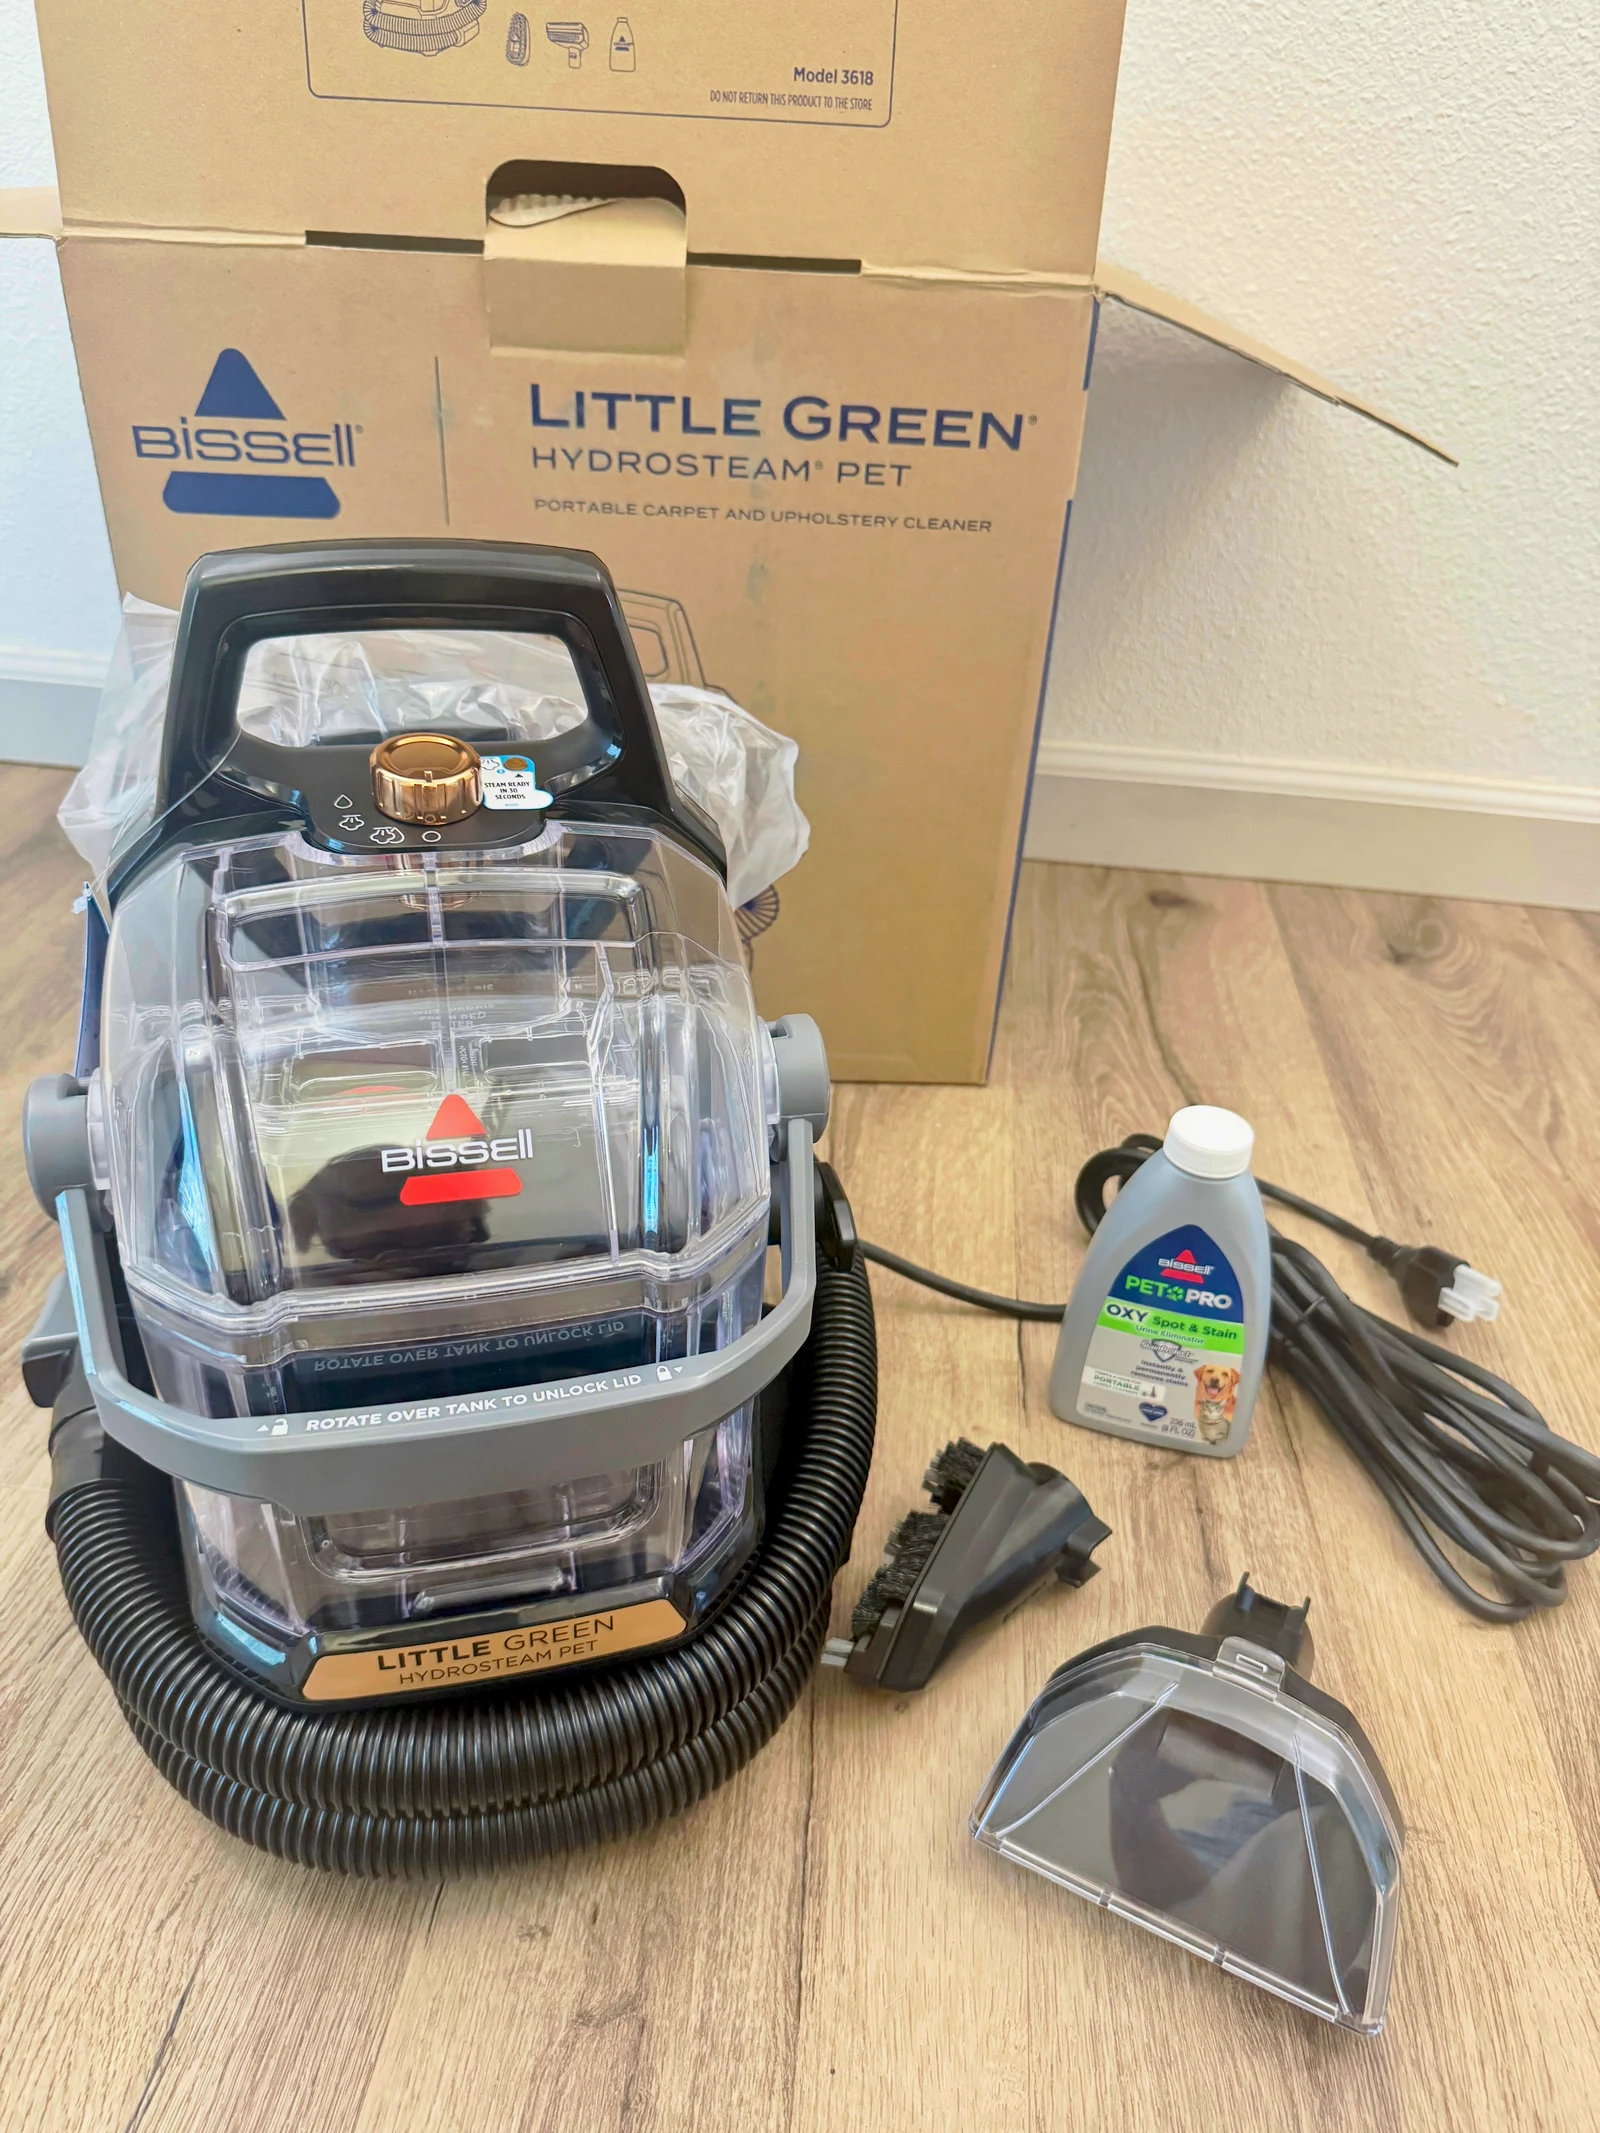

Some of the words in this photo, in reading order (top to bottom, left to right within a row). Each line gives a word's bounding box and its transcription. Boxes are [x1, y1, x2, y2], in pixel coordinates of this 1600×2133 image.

[793, 66, 837, 84] Model
[841, 70, 874, 86] 3618
[710, 89, 721, 103] DO
[722, 91, 737, 104] NOT
[739, 92, 769, 105] RETURN
[770, 93, 786, 106] THIS
[788, 94, 821, 108] PRODUCT
[823, 96, 833, 108] TO
[835, 97, 848, 109] THE
[850, 98, 872, 111] STORE
[529, 383, 761, 438] LITTLE
[836, 461, 913, 488] PET
[535, 498, 638, 517] PORTABLE
[643, 503, 720, 521] CARPET
[725, 507, 766, 523] AND
[771, 511, 899, 530] UPHOLSTERY
[903, 515, 993, 533] CLEANER
[1125, 1275, 1169, 1298] PET
[1185, 1288, 1232, 1310] PRO
[1106, 1303, 1148, 1322] OXY
[1152, 1315, 1185, 1332] Spot
[1188, 1323, 1198, 1333] &
[1202, 1325, 1237, 1340] Stain
[1136, 1325, 1159, 1336] Urine
[1160, 1330, 1204, 1344] Eliminator
[1094, 1374, 1140, 1391] PORTABLE
[1130, 1370, 1164, 1382] removes
[305, 1412, 382, 1432] ROTATE
[387, 1406, 441, 1423] OVER
[446, 1399, 497, 1416] TANK
[501, 1394, 527, 1407] TO
[532, 1381, 609, 1402] UNLOCK
[613, 1374, 642, 1389] LID
[1170, 1417, 1183, 1426] 236
[1184, 1421, 1196, 1429] mL
[1170, 1426, 1180, 1434] FL
[378, 1639, 491, 1671] LITTLE
[504, 1615, 614, 1652] GREEN
[400, 1650, 552, 1685] HYDROSTEAM
[559, 1639, 599, 1659] PET
